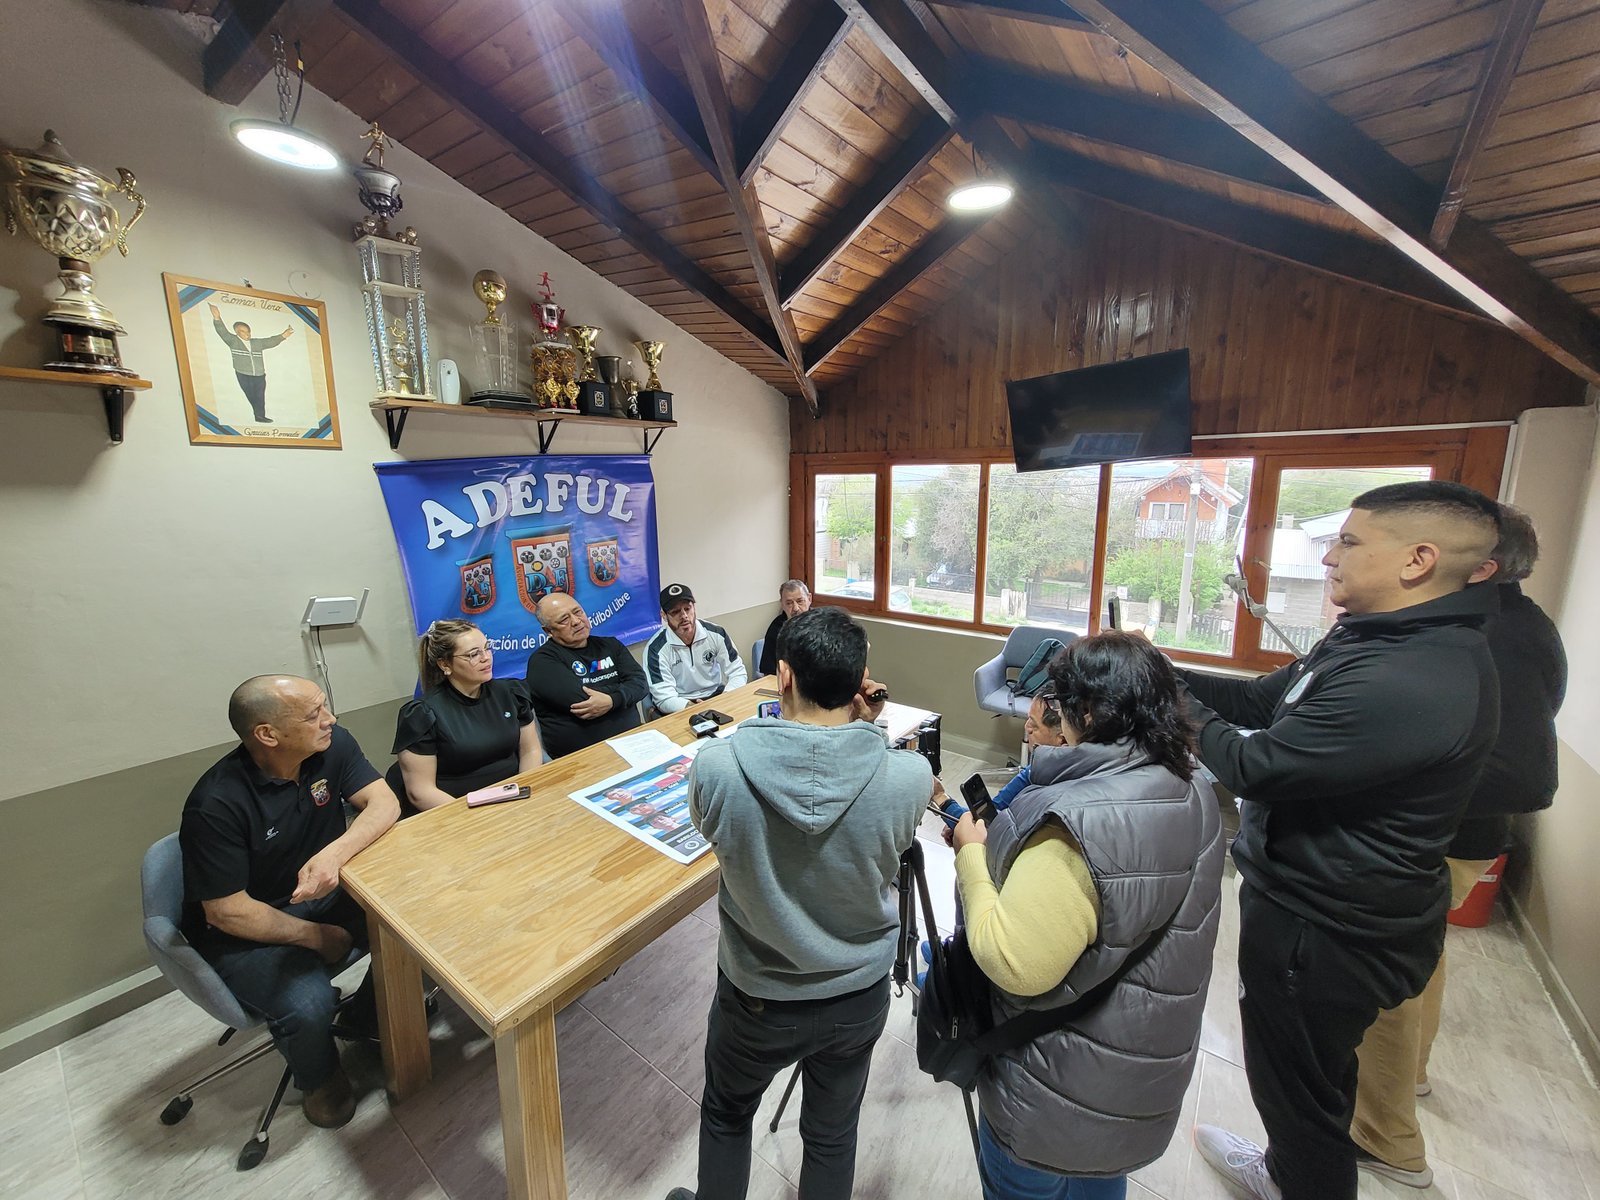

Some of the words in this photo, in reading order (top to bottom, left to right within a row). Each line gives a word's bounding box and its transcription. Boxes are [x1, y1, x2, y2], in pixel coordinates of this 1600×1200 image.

[420, 473, 634, 550] ADEFUL
[588, 604, 614, 629] Fútbol
[611, 592, 631, 612] Libre
[521, 635, 536, 650] de
